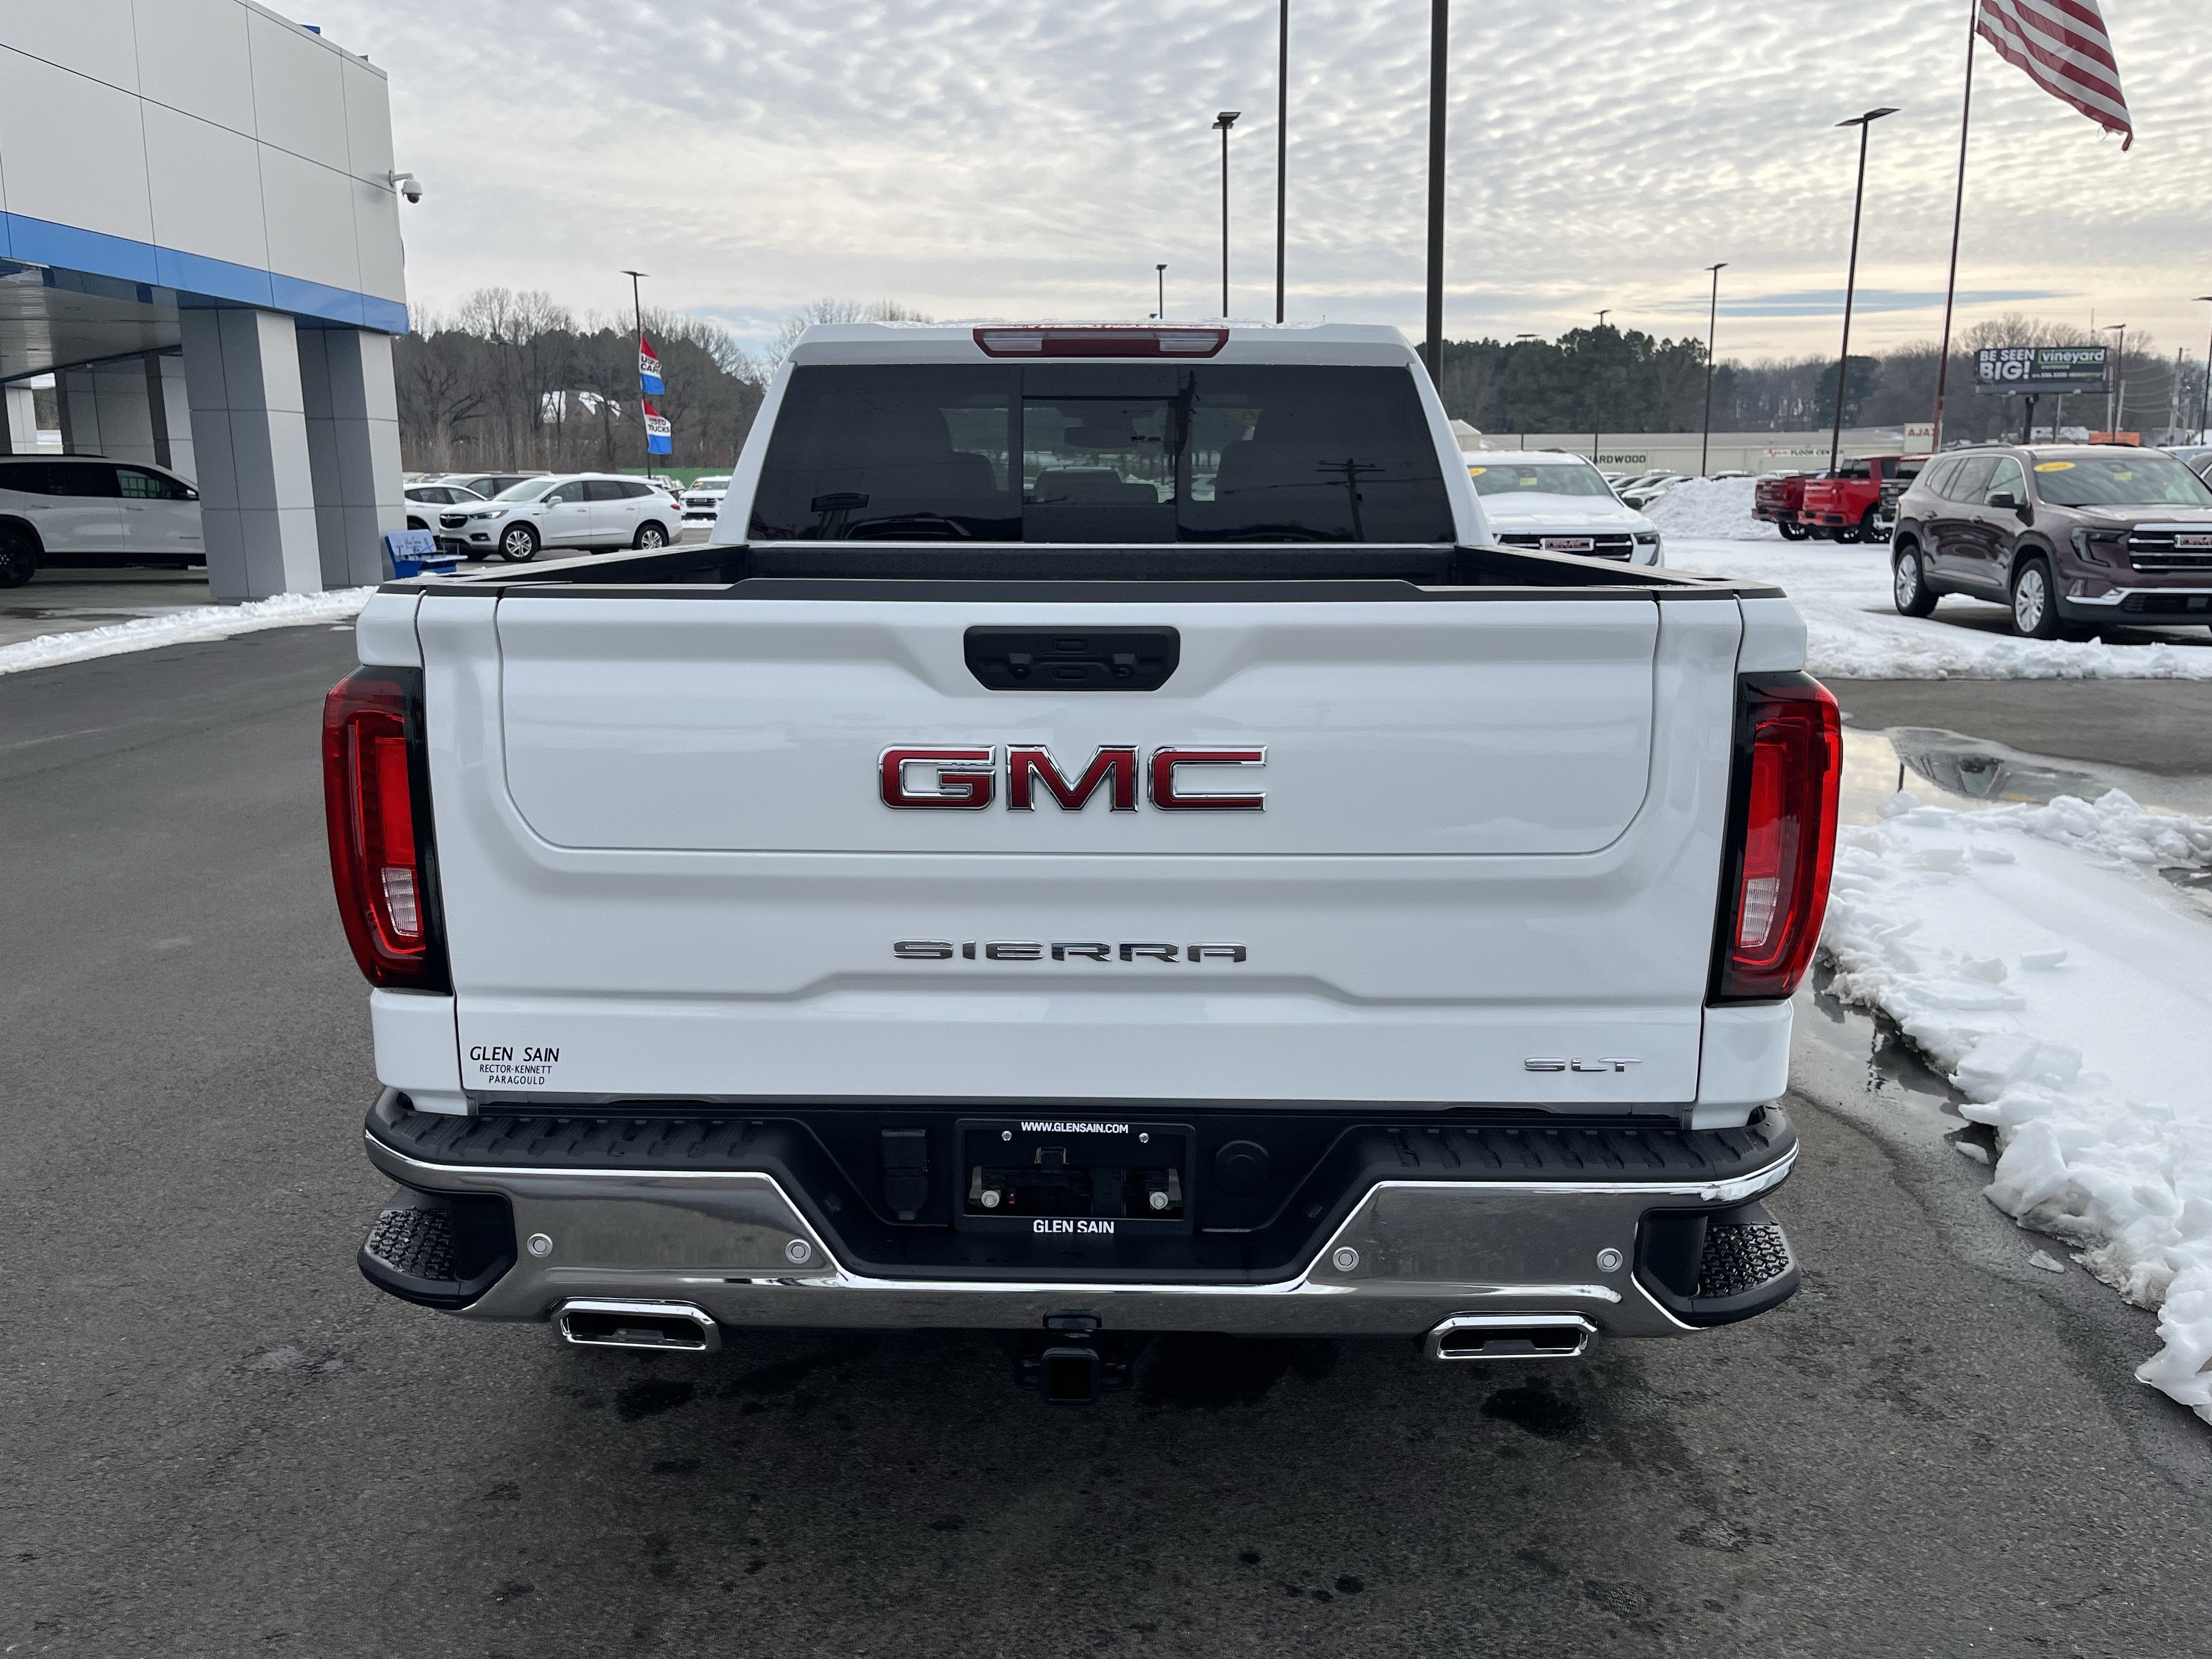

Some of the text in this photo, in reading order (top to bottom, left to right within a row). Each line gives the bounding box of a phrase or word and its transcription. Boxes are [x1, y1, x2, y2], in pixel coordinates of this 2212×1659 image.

[1979, 349, 2035, 362] BE SEEN
[2042, 348, 2105, 364] vineyard
[1979, 360, 2030, 380] BIG!
[1909, 428, 1934, 437] AJA
[878, 744, 1268, 812] GMC
[894, 940, 1248, 963] SIERRA
[470, 1046, 560, 1062] GLEN SAIN
[479, 1064, 553, 1074] RECTOR-KENNETT
[1524, 1057, 1642, 1072] SLT
[488, 1075, 545, 1085] PARAGOULD
[1021, 1121, 1129, 1134] WWW.GLENSAIN.COM
[1033, 1220, 1115, 1234] GLEN SAIN
